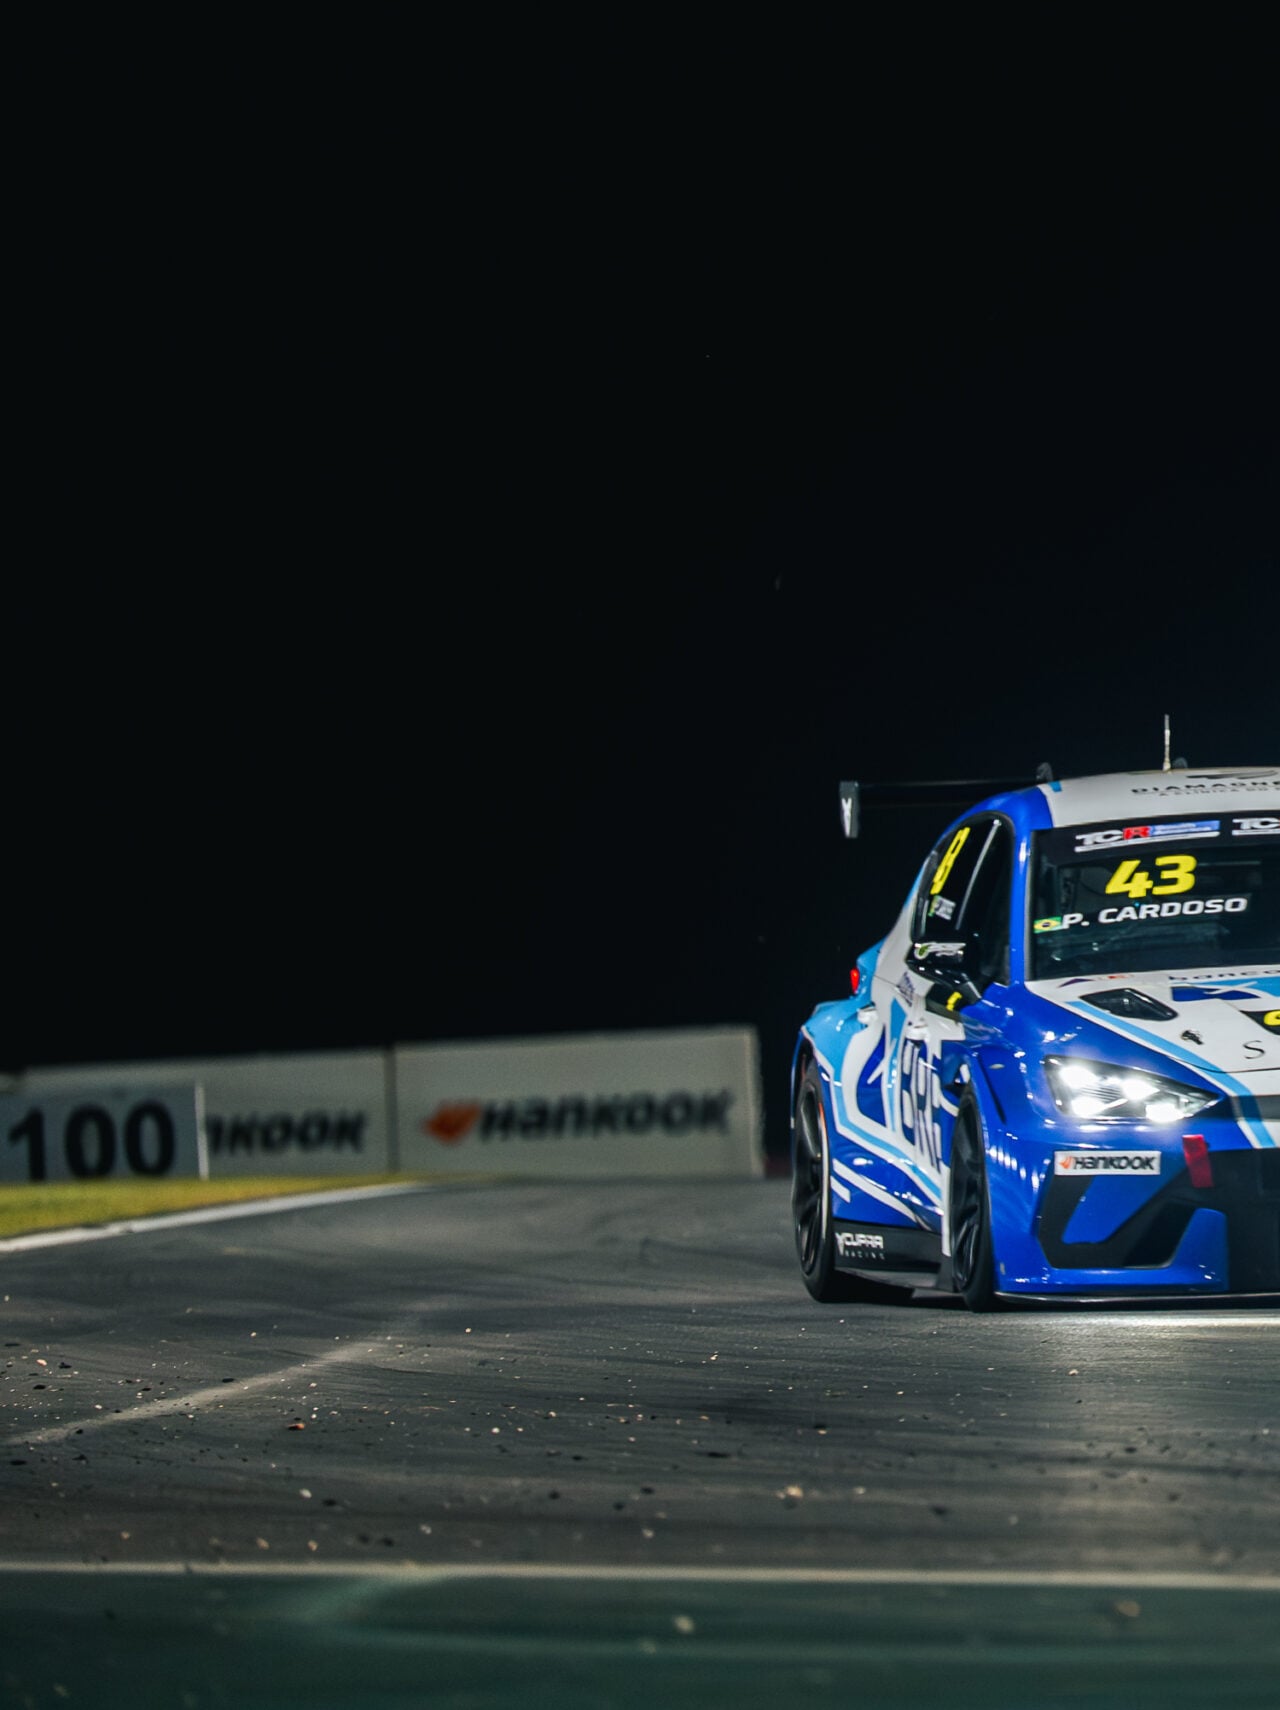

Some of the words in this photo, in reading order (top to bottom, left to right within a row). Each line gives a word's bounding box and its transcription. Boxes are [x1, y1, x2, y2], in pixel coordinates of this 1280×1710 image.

[1105, 854, 1198, 898] 43
[1061, 912, 1090, 929] P.
[1098, 897, 1248, 924] CARDOSO
[7, 1100, 176, 1182] 100
